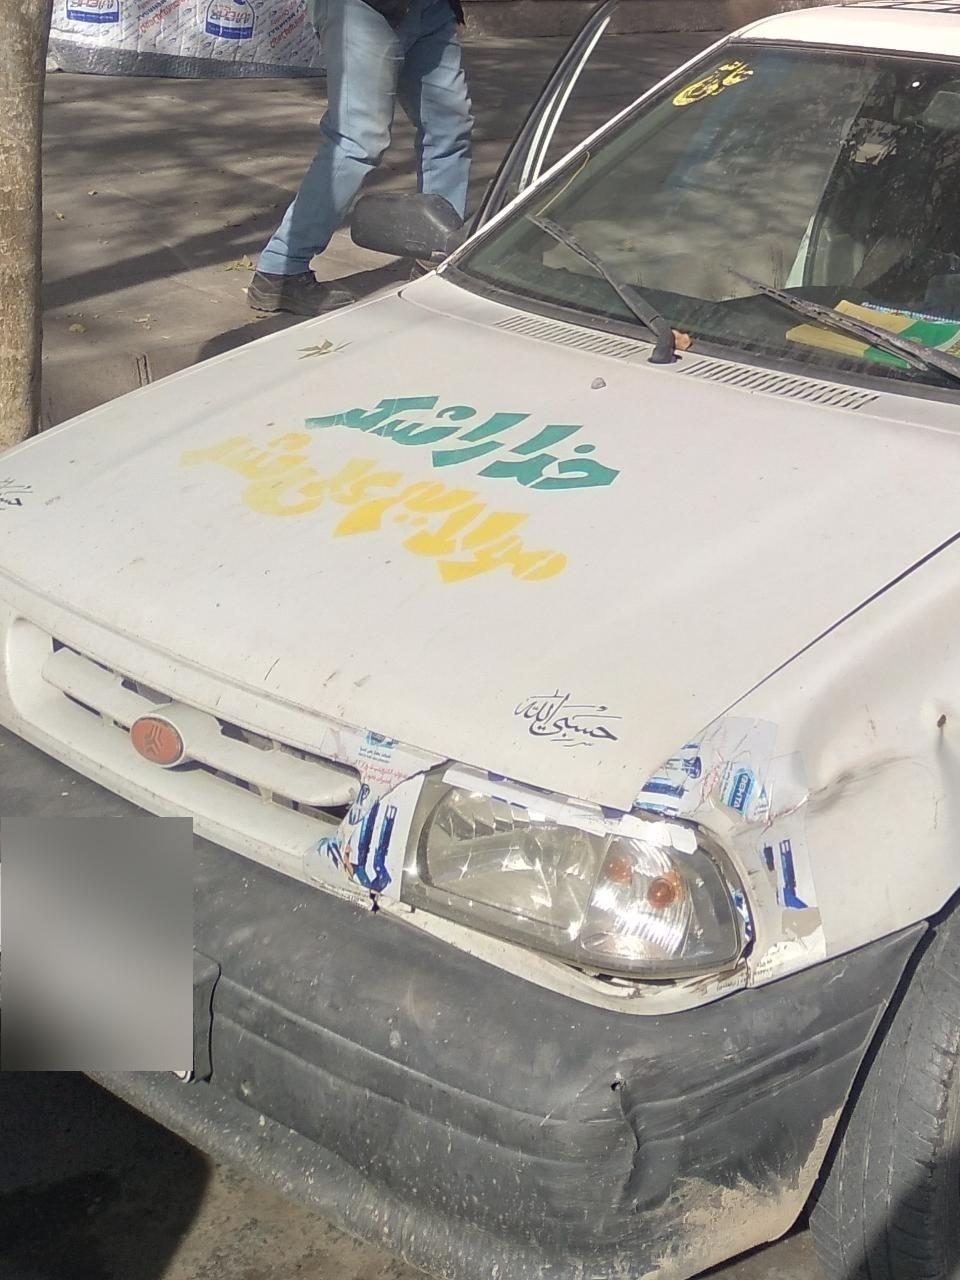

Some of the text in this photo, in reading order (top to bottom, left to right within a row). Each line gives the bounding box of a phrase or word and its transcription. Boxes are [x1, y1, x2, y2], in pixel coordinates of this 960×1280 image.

[304, 395, 622, 491] خدا را شکر
